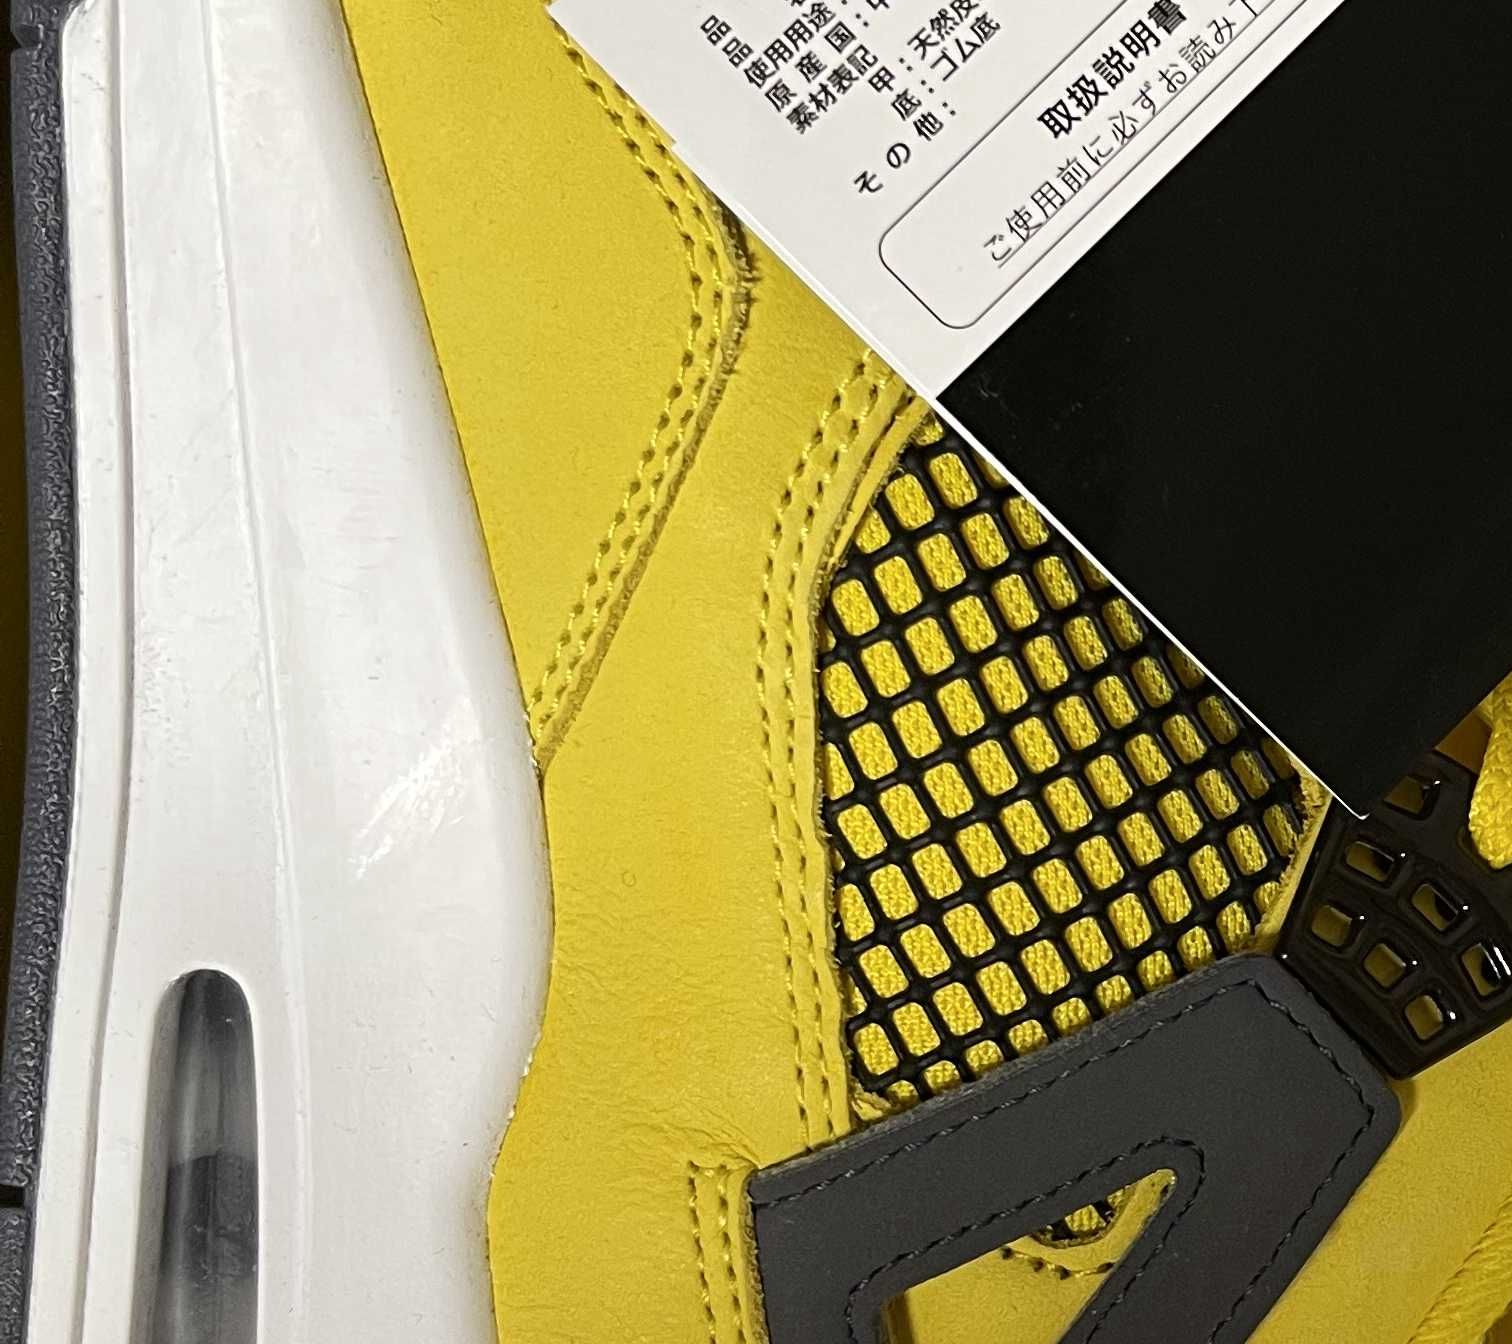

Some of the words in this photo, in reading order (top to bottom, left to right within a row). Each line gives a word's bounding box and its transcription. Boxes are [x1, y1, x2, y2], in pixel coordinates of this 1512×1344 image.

[929, 11, 1001, 82] ゴム底
[785, 43, 879, 135] 素材表記
